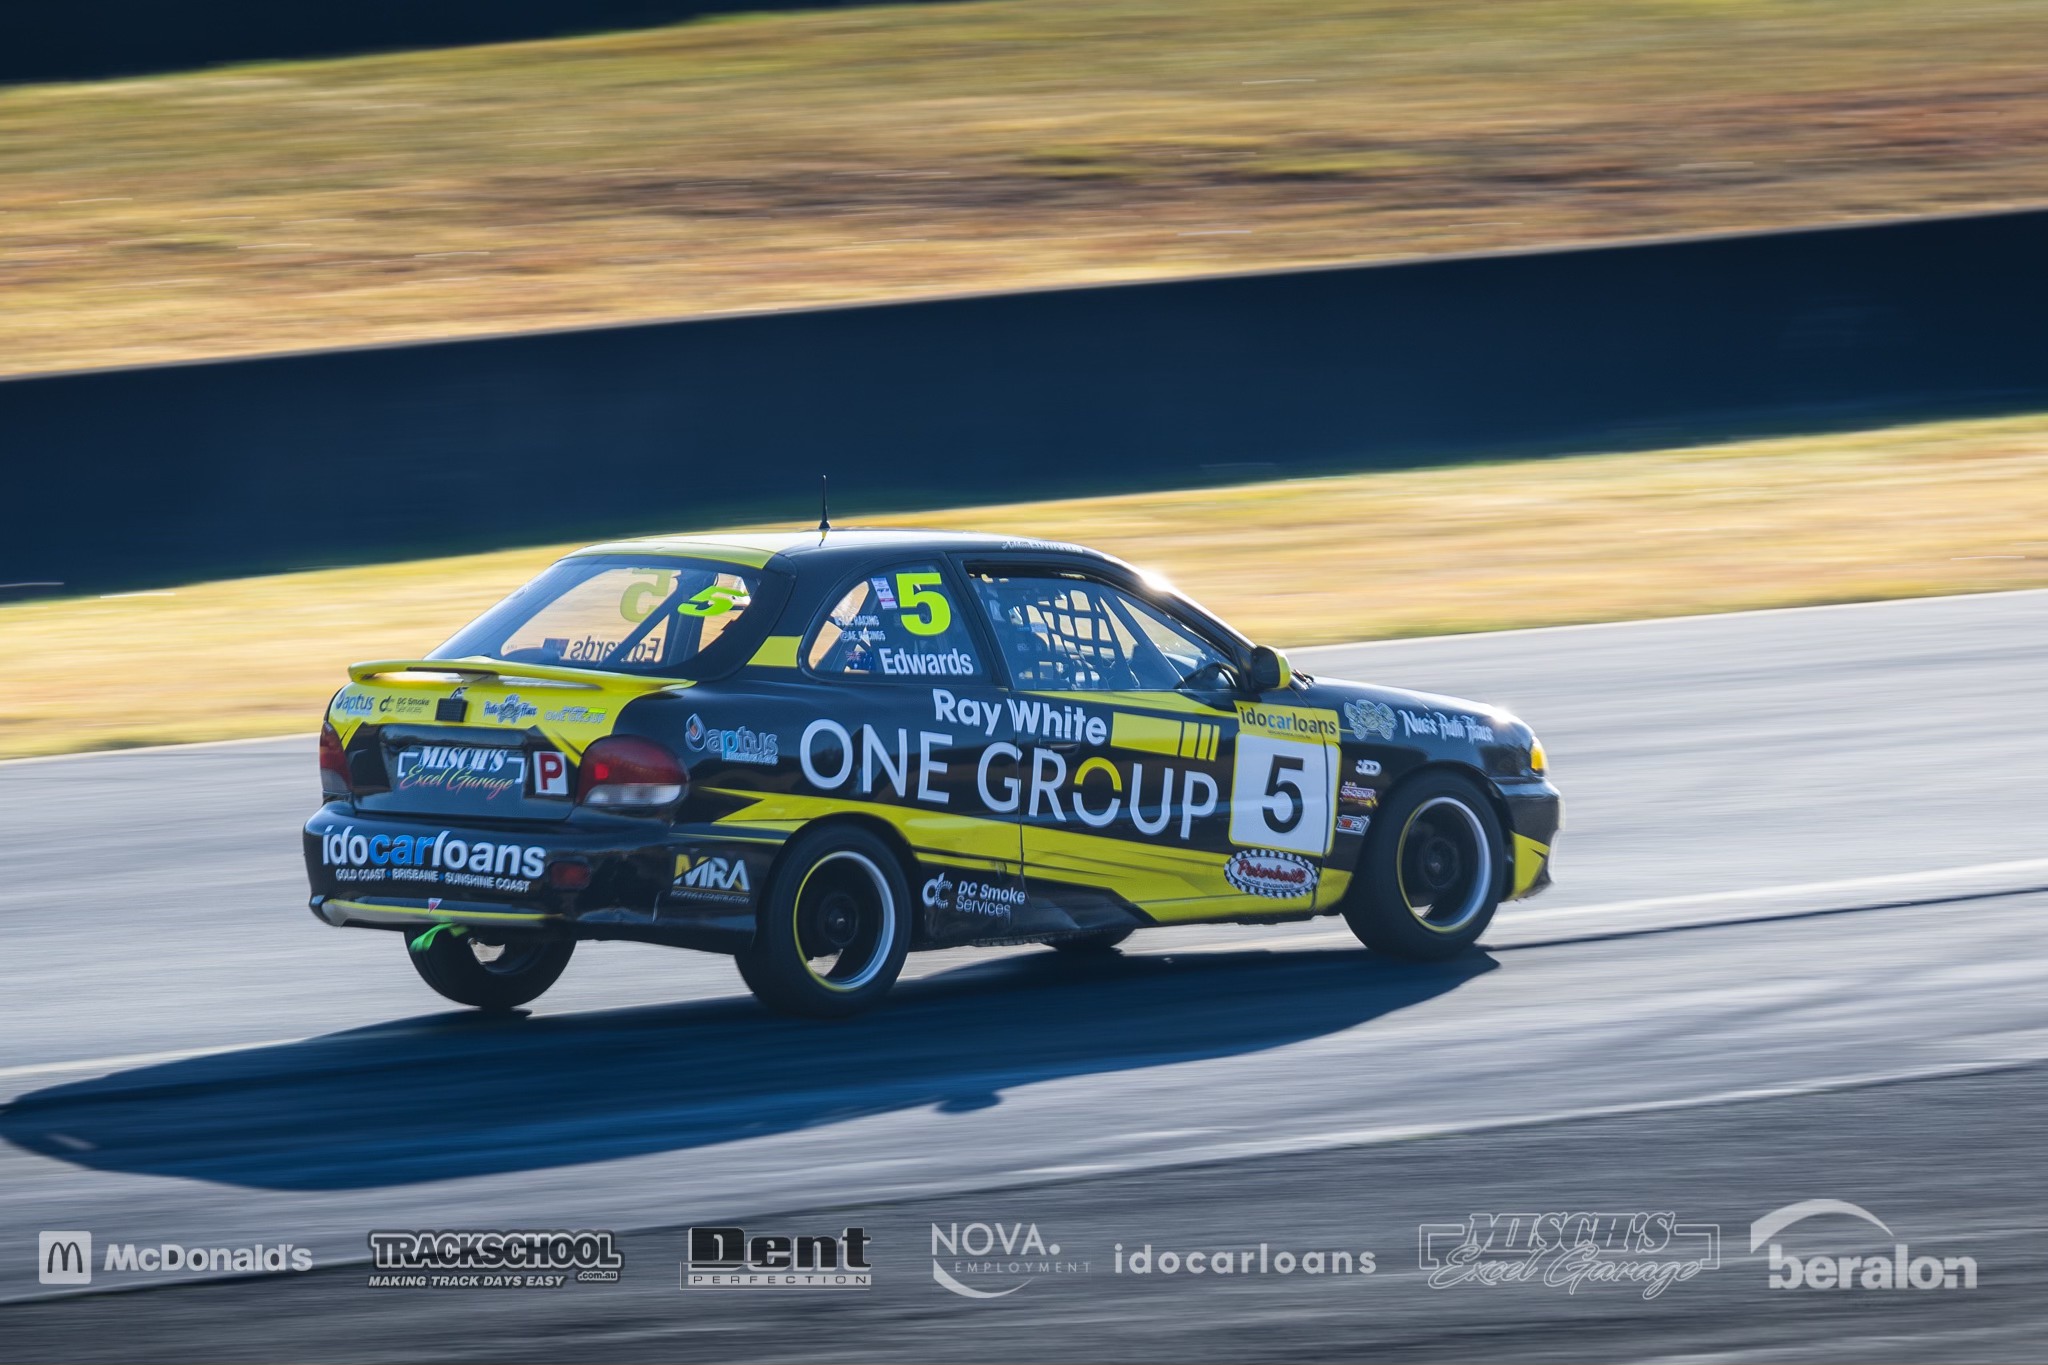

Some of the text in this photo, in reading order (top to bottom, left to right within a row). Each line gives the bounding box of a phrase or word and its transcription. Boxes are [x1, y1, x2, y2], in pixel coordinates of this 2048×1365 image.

[677, 585, 749, 617] 5
[895, 572, 951, 636] 5
[879, 648, 974, 675] Edwards
[932, 688, 1107, 746] Ray White
[1240, 706, 1336, 735] idocarloans
[417, 746, 509, 772] MISCH'S
[706, 725, 779, 761] aptus
[399, 765, 515, 800] Excel Garage
[539, 752, 563, 791] P
[800, 718, 1219, 841] ONE GROUP
[1262, 754, 1304, 834] 5
[322, 825, 548, 880] idocarloans
[336, 868, 532, 893] GOLD COAST BRISBANE SUNSHINE COAST
[673, 854, 750, 892] MRA
[956, 895, 1010, 917] Services
[958, 881, 1025, 905] DC Smoke
